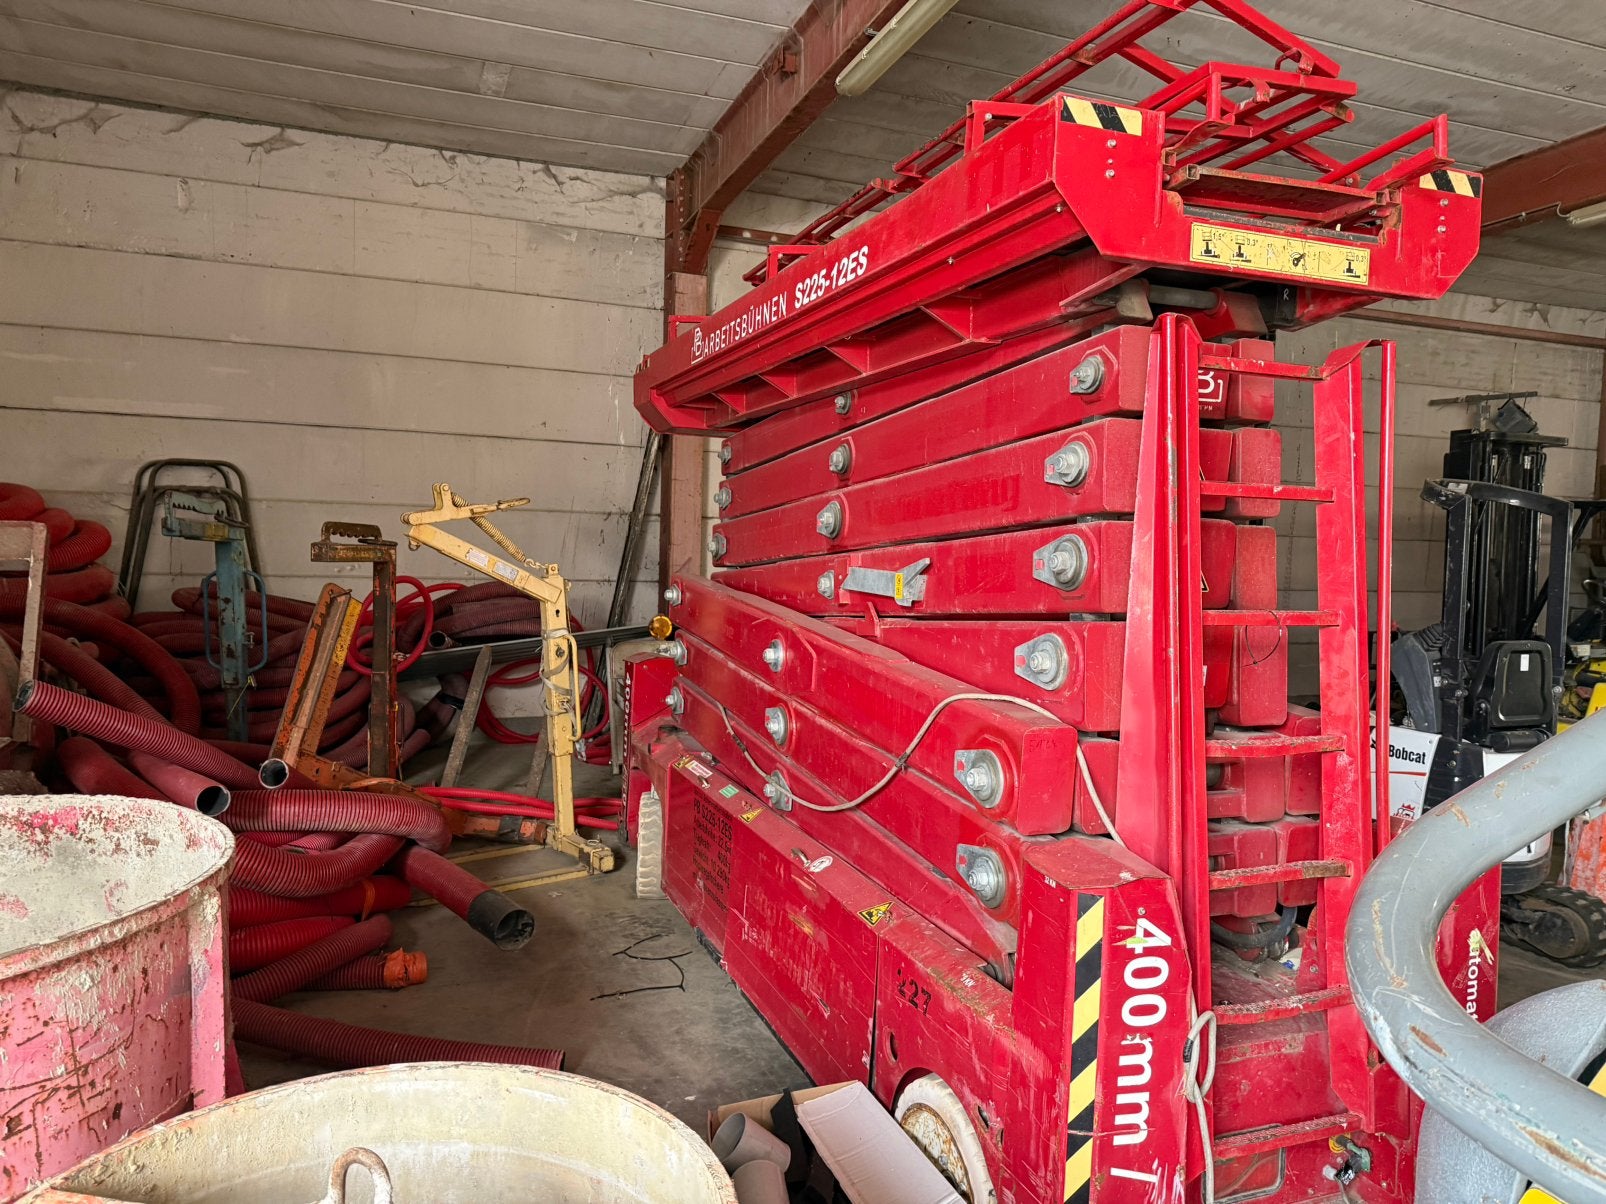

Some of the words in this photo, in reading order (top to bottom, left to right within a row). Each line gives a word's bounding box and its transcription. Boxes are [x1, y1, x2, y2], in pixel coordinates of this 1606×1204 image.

[703, 291, 787, 358] ARBEITSBÜHNEN
[794, 245, 869, 310] S225-12ES
[1389, 744, 1427, 765] Bobcat
